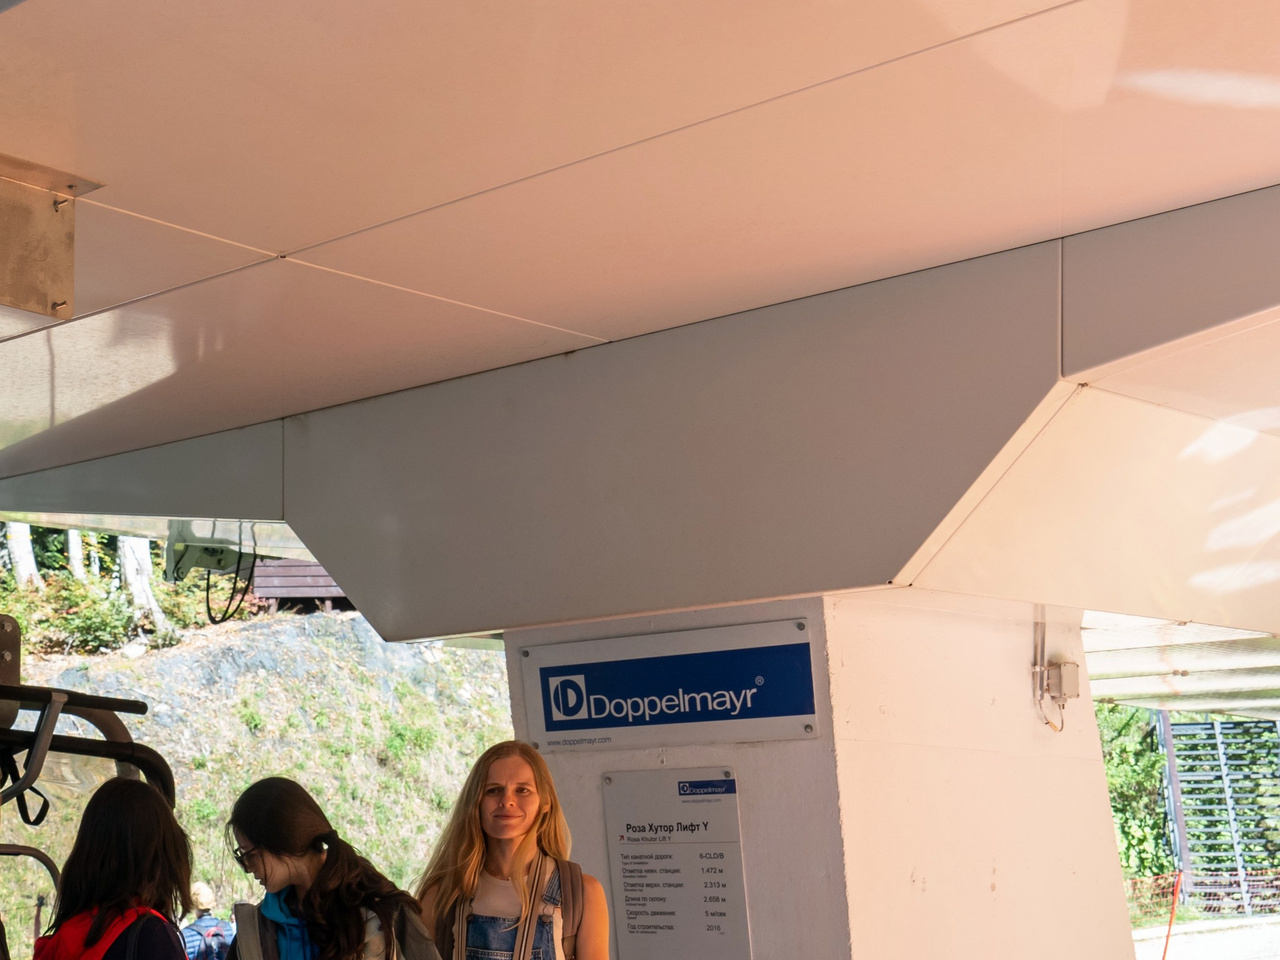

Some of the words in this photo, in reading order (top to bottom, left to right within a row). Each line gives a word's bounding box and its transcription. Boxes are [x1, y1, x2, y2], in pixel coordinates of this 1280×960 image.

[547, 736, 612, 747] www.doppelmayr.com
[626, 824, 646, 833] Роза
[648, 823, 674, 834] Хутор
[676, 822, 700, 834] Лифт
[702, 821, 709, 831] Y
[626, 909, 649, 917] Скорость
